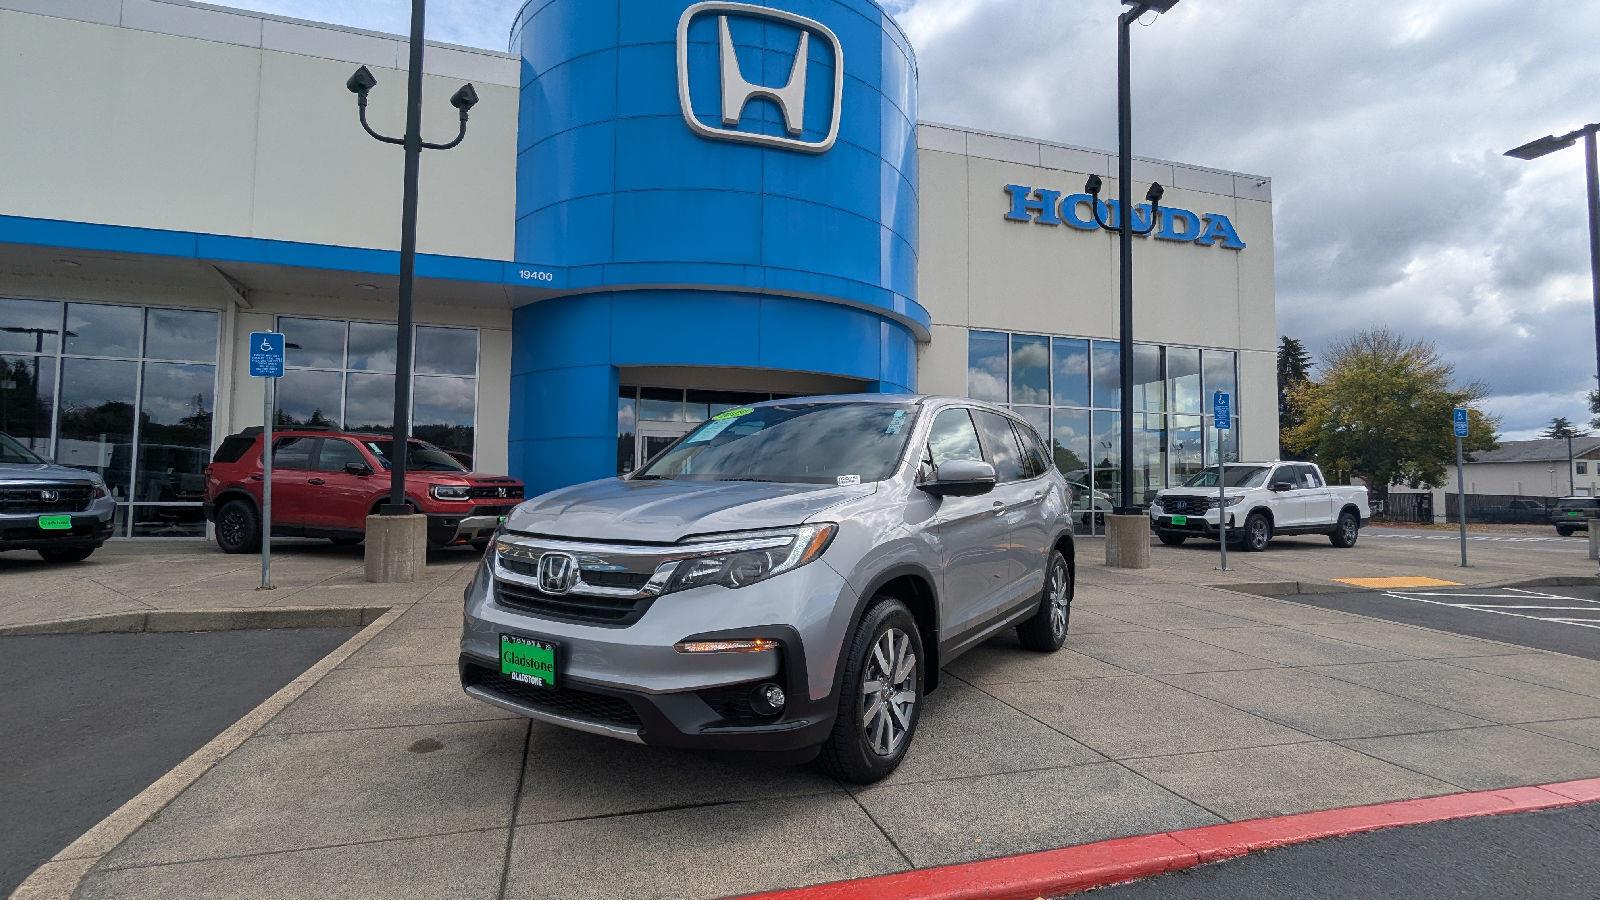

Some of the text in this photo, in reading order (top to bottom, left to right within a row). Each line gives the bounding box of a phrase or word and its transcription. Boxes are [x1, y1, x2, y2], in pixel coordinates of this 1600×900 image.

[1004, 184, 1246, 250] HONDA
[519, 270, 553, 281] 19400
[511, 636, 542, 648] TOYOTA
[503, 650, 553, 673] Gladstone
[511, 671, 543, 686] GLADSTONE
